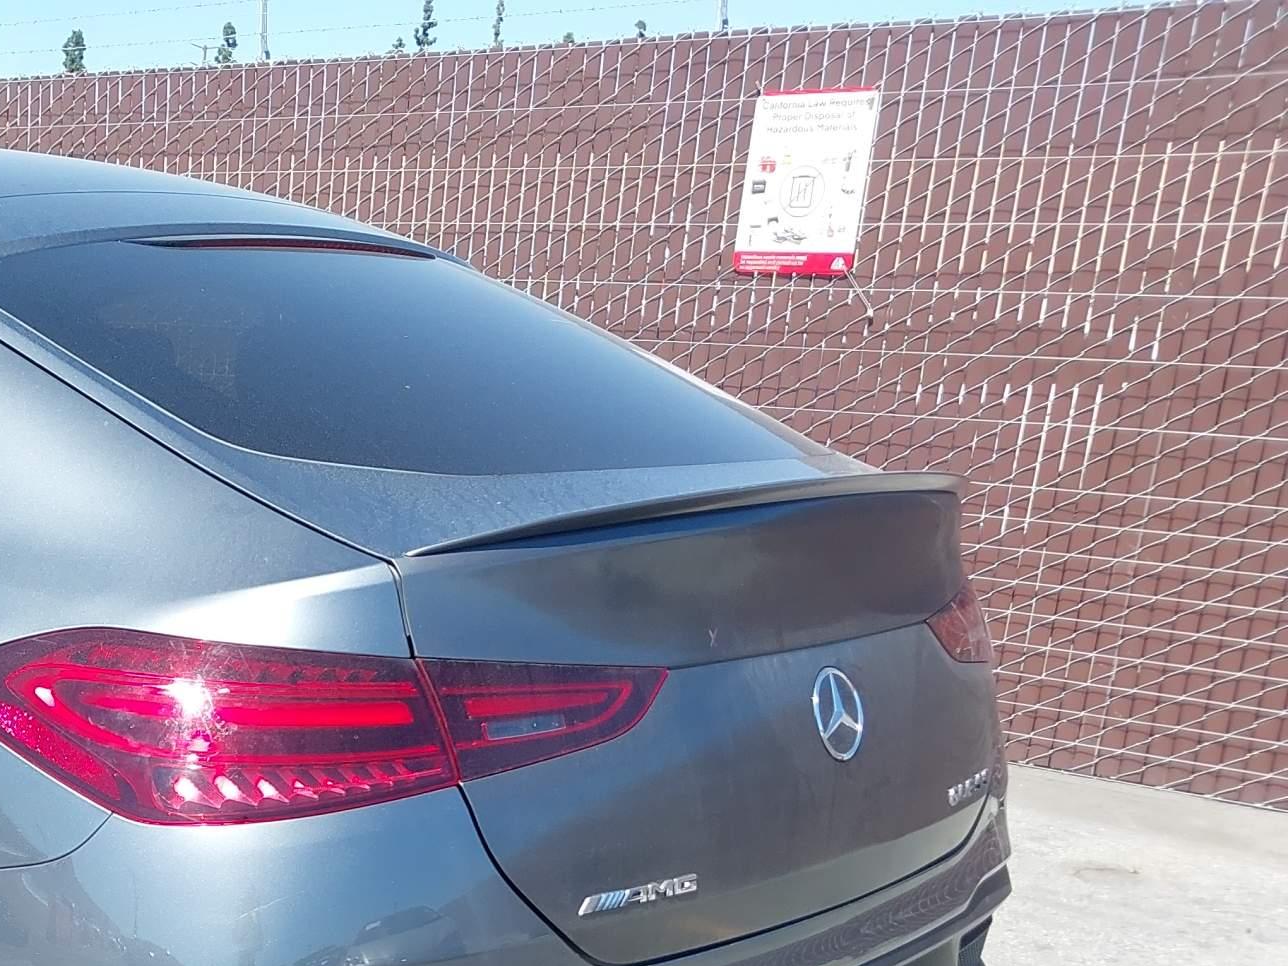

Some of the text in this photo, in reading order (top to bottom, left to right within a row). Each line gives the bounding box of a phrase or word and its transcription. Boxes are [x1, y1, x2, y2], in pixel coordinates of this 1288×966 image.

[762, 101, 806, 110] California
[808, 99, 827, 108] Law
[772, 112, 801, 121] Proper
[766, 125, 814, 134] Hazardous
[620, 873, 698, 907] AMG
